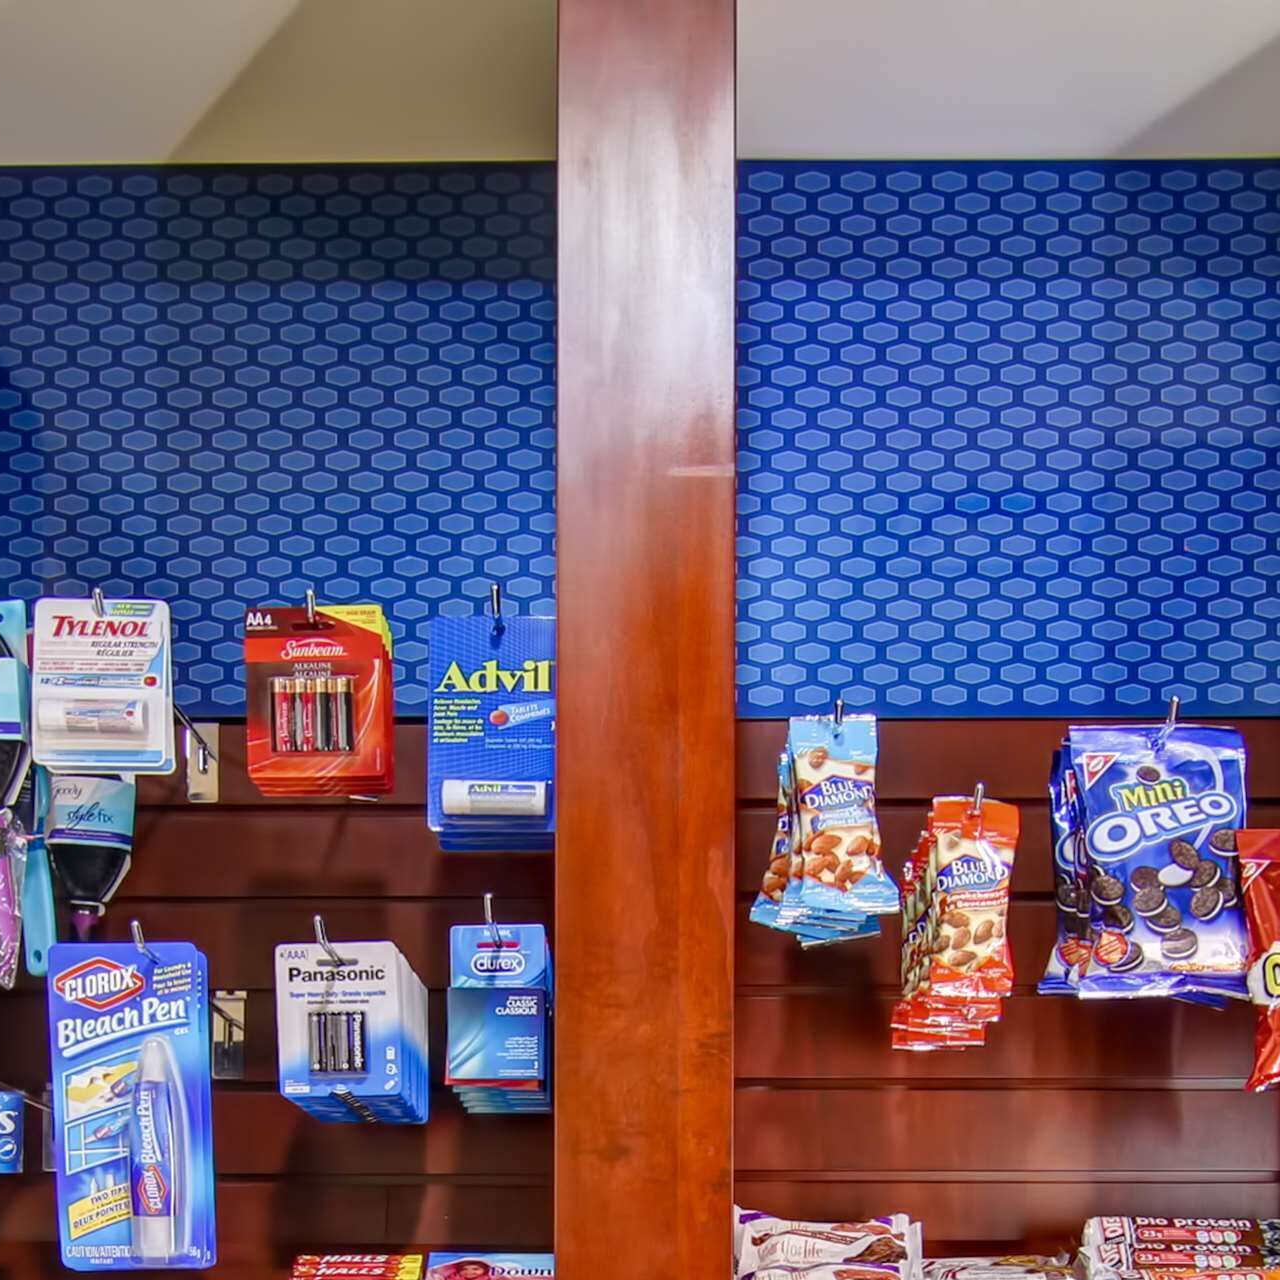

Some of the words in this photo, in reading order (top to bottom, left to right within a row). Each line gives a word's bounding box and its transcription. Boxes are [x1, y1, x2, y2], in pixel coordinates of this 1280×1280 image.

[52, 615, 150, 638] TYLENOL
[280, 640, 349, 661] Sunbeam
[433, 659, 552, 694] Advil
[804, 786, 873, 810] DIAMOND
[819, 779, 855, 798] BLUE
[1122, 782, 1187, 812] Mini
[1092, 795, 1232, 854] OREO
[936, 864, 1008, 892] DIAMOND
[951, 858, 988, 876] BLUE
[288, 964, 386, 983] Panasonic
[476, 956, 520, 971] durex
[63, 965, 136, 1002] CLOROX
[495, 1007, 538, 1016] CLASSIQUE
[506, 1000, 538, 1008] CLASSIC
[57, 1006, 140, 1049] Bleach
[141, 997, 187, 1025] Pen
[352, 1013, 364, 1068] Panasonic
[139, 1117, 158, 1164] Bleach
[1136, 1215, 1168, 1227] bio
[1173, 1217, 1251, 1231] protein
[317, 1265, 385, 1275] HALLS
[321, 1254, 389, 1264] HALLS
